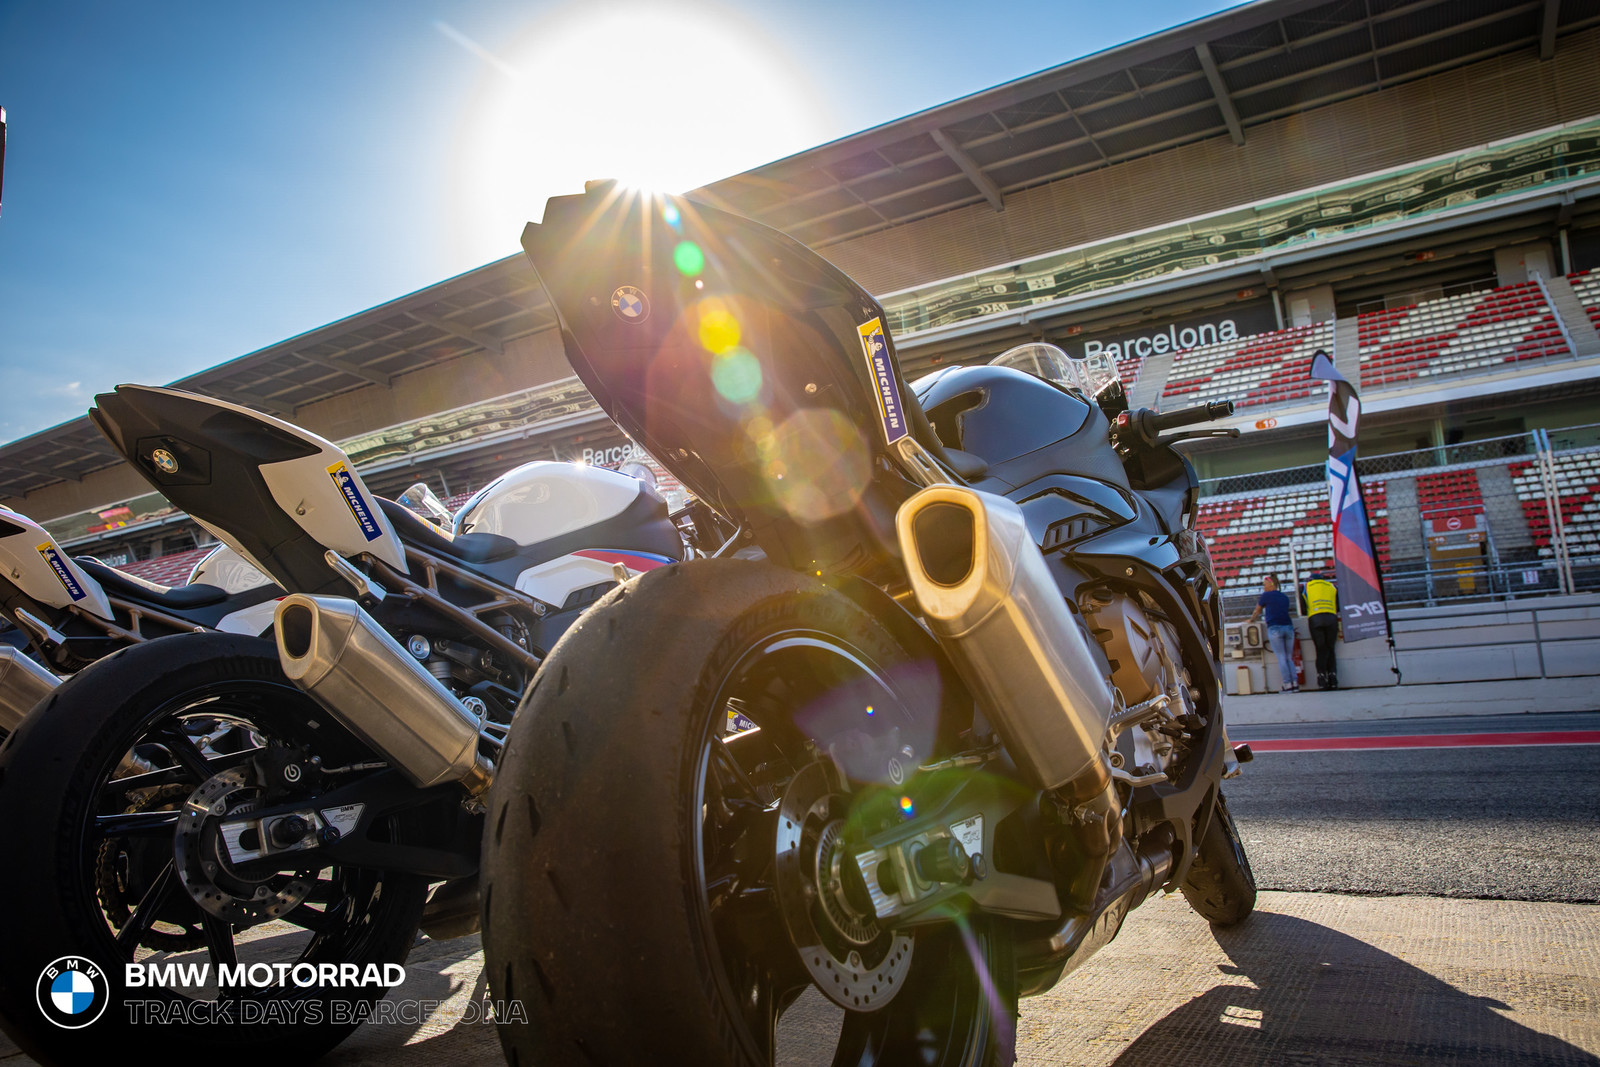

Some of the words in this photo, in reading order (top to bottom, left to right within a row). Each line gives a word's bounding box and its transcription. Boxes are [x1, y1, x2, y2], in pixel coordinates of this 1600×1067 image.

[1084, 319, 1239, 363] Barcelona
[874, 357, 900, 429] MICHELIN
[343, 486, 375, 533] MICHELIN
[50, 560, 80, 595] MICHELIN
